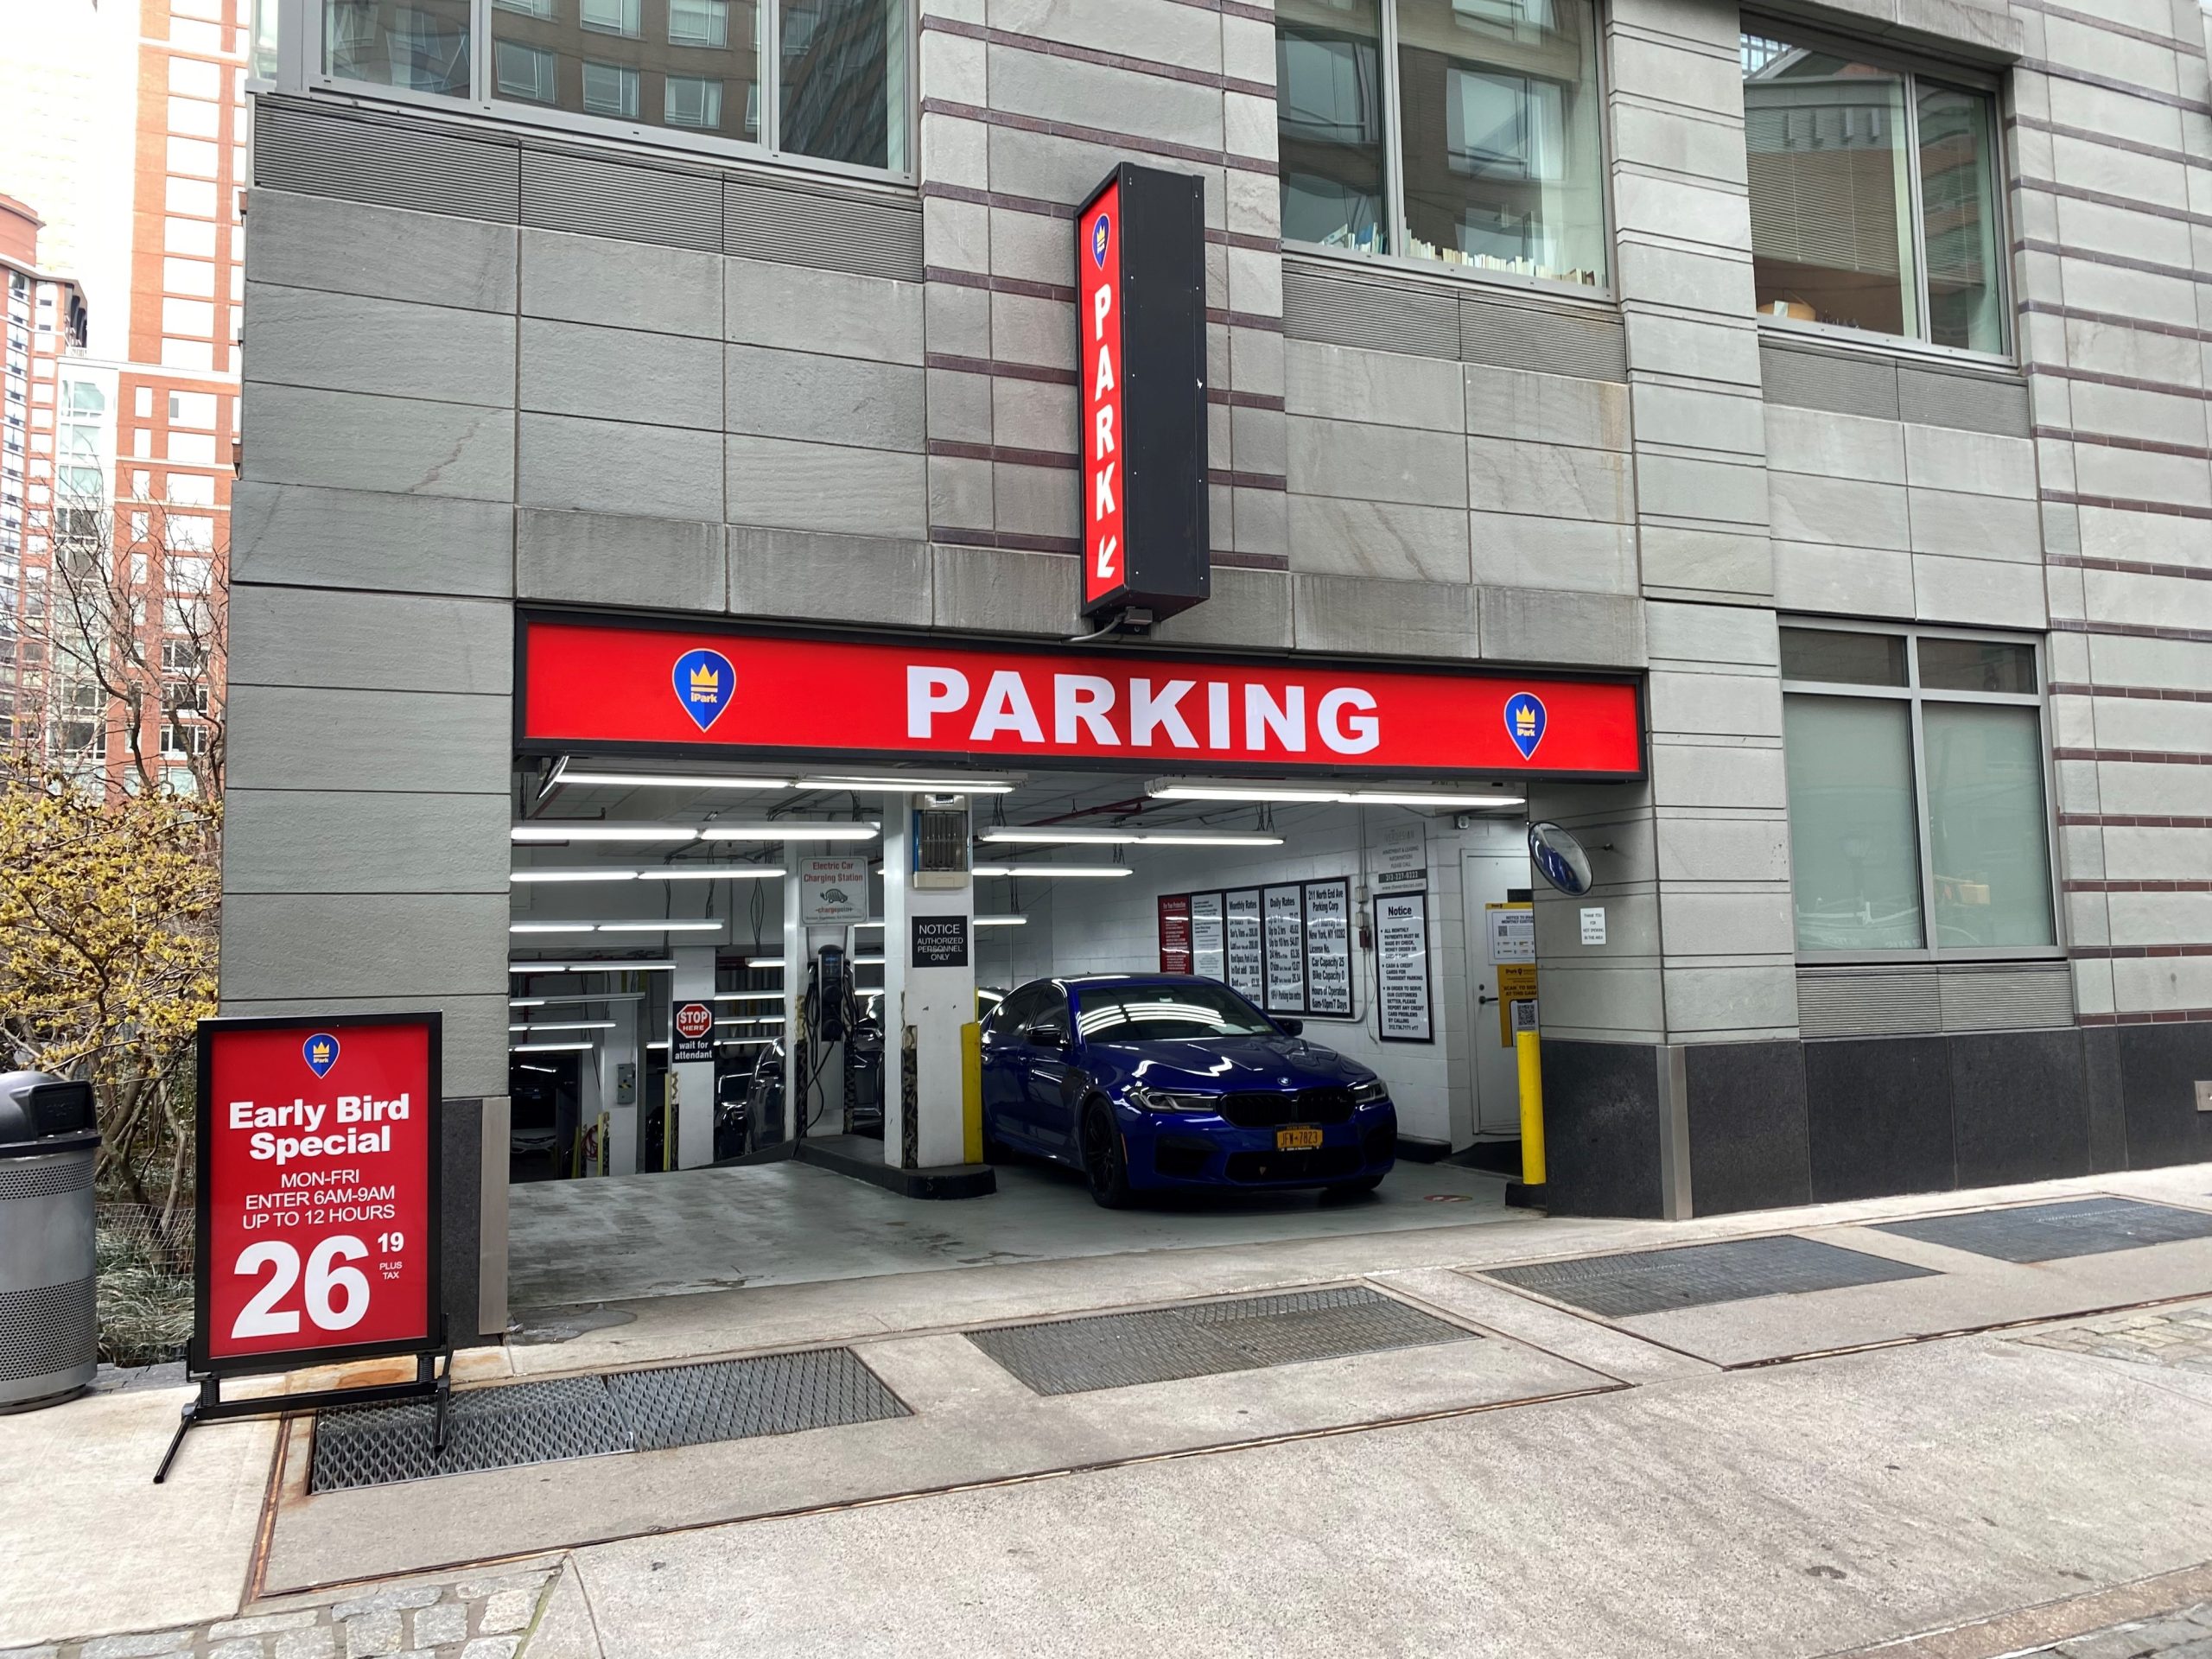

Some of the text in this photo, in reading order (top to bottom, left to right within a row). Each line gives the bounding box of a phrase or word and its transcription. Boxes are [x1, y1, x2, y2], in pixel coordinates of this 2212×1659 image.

[1094, 283, 1116, 522] PARK
[690, 691, 717, 702] iPark
[906, 664, 1380, 755] PARKING
[1516, 728, 1535, 736] iPark
[813, 861, 839, 870] Electric
[804, 873, 863, 884] Charging Station
[1316, 889, 1327, 899] North
[1230, 900, 1244, 912] Monthly
[1245, 899, 1257, 909] Rates
[1270, 897, 1295, 909] Daily Rates
[1313, 900, 1338, 913] Parking Corp
[1388, 906, 1412, 917] Notice
[919, 924, 960, 934] NOTICE
[1328, 929, 1333, 939] NY
[917, 937, 963, 945] AUTHORIZED
[1309, 944, 1323, 954] License
[1320, 957, 1338, 969] Capacity
[1339, 957, 1344, 967] 25
[1313, 970, 1322, 980] Bike
[1323, 969, 1341, 982] Capacity
[1312, 985, 1323, 995] Hours
[1328, 986, 1347, 998] Operation
[1337, 999, 1347, 1012] Days
[680, 1011, 709, 1024] STOP
[679, 1040, 709, 1050] wait for
[675, 1050, 712, 1060] attendant
[229, 1093, 410, 1131] Early Bird
[250, 1125, 391, 1165] Special
[281, 1169, 359, 1189] MON-FRI
[245, 1185, 396, 1210] ENTER 6AM-9AM
[243, 1205, 396, 1230] UP TO 12 HOURS
[379, 1261, 404, 1271] PLUS
[382, 1270, 400, 1281] TAX
[231, 1231, 404, 1339] 26 19
